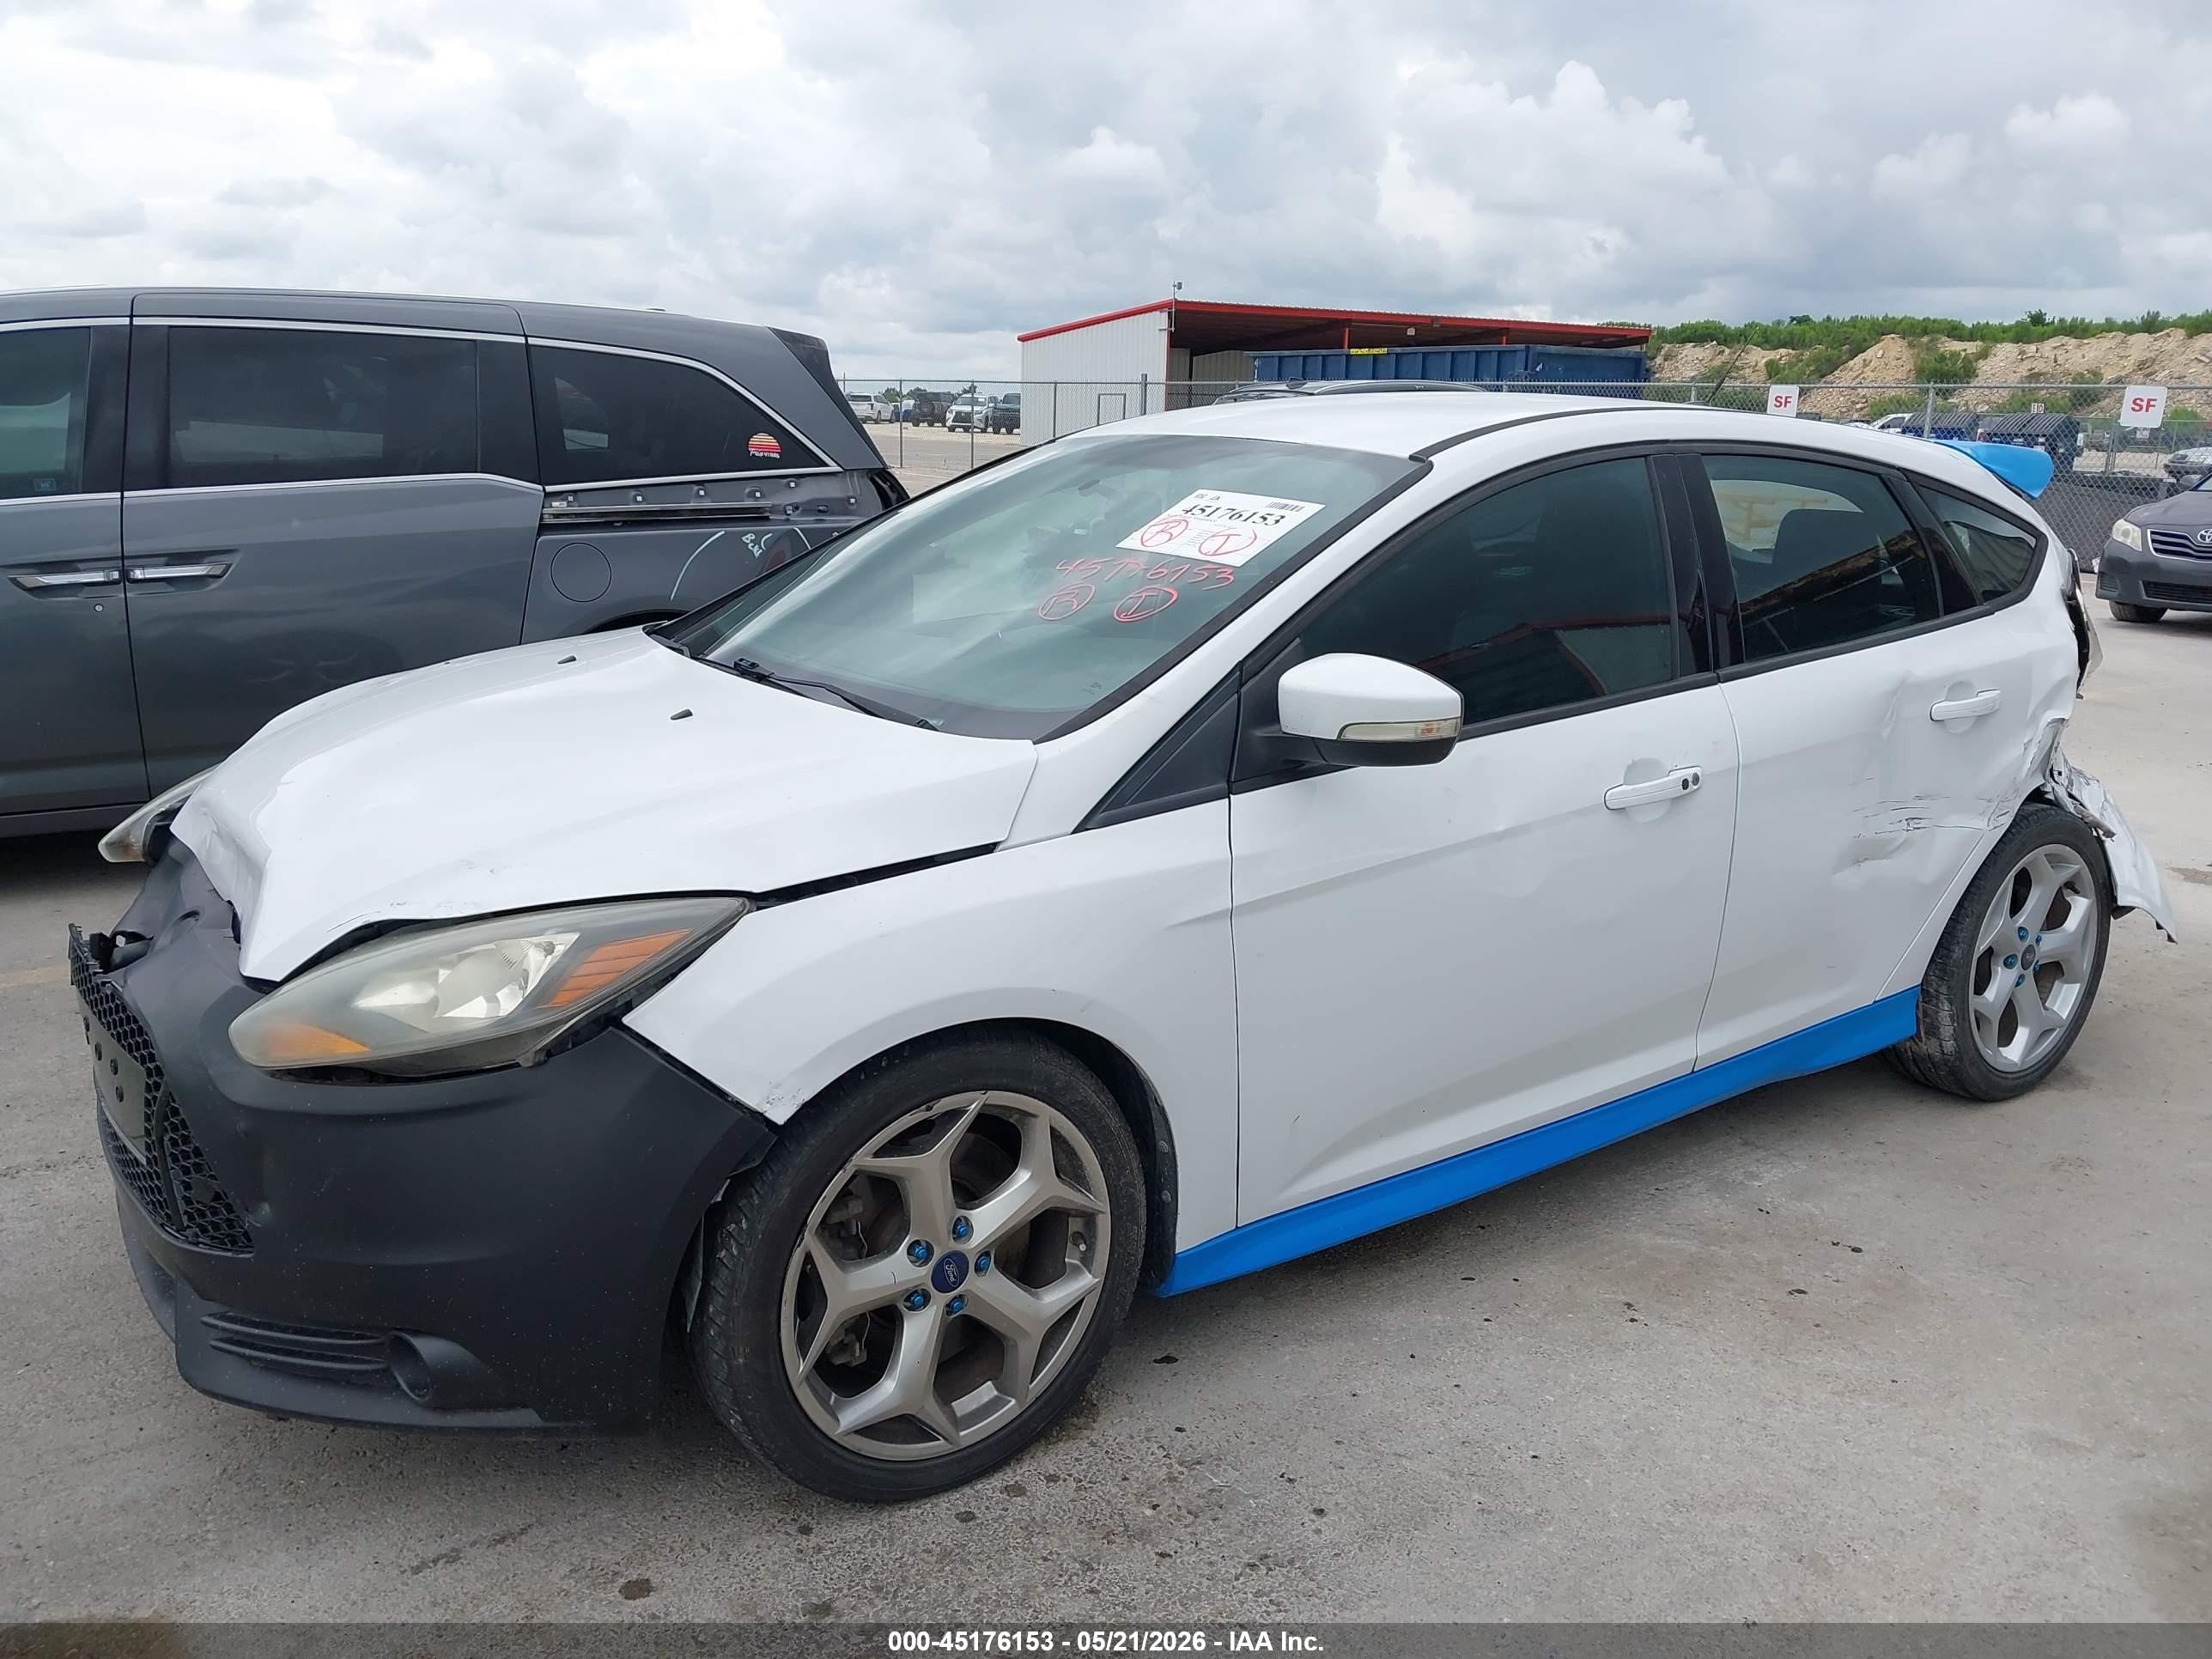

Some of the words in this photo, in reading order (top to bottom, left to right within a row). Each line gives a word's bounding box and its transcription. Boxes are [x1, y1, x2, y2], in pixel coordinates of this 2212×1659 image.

[1773, 395, 1792, 408] SF
[2130, 397, 2158, 413] SF
[1182, 503, 1286, 526] 45176153
[945, 1264, 957, 1283] Ford
